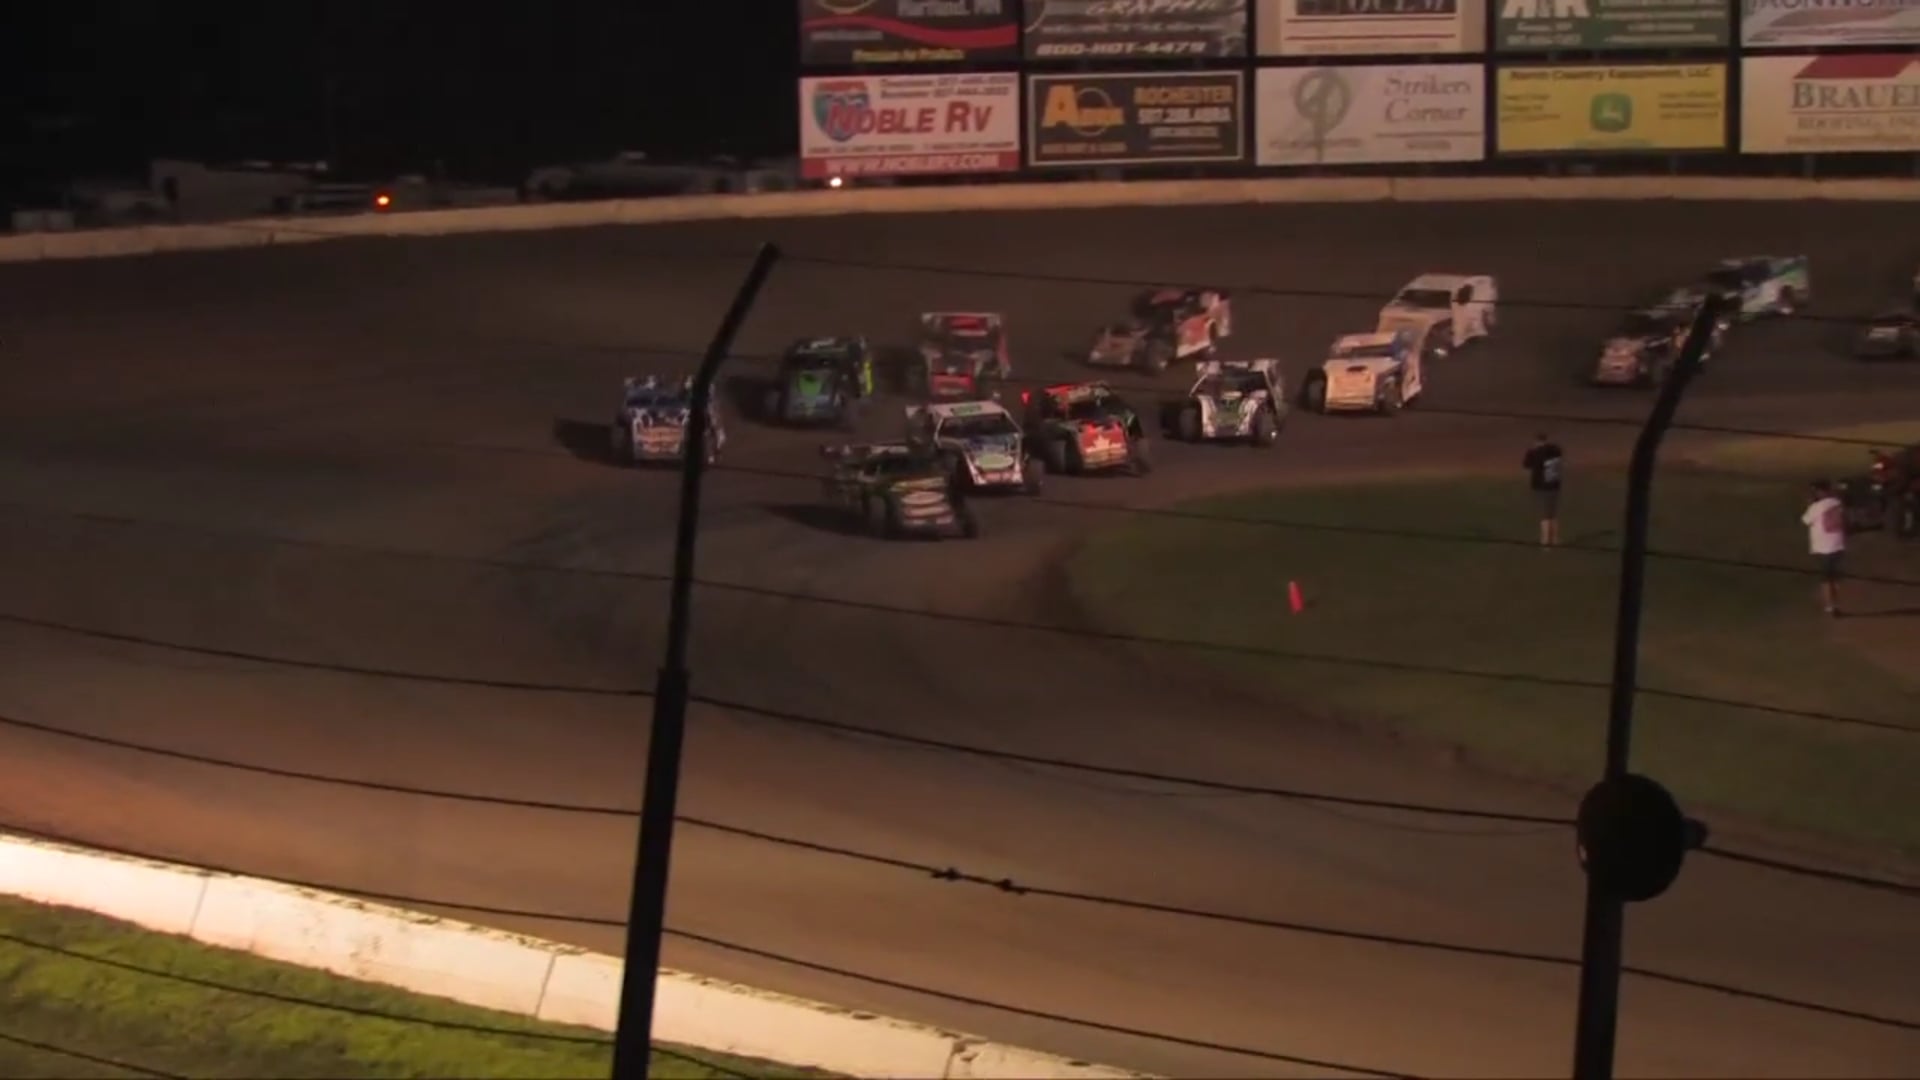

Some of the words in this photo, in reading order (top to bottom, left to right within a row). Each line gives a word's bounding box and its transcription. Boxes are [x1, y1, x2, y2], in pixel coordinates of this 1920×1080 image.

[1134, 86, 1233, 105] ROCHESTER
[826, 101, 937, 136] NOBLE
[945, 101, 993, 133] RV
[1384, 98, 1469, 123] Corner
